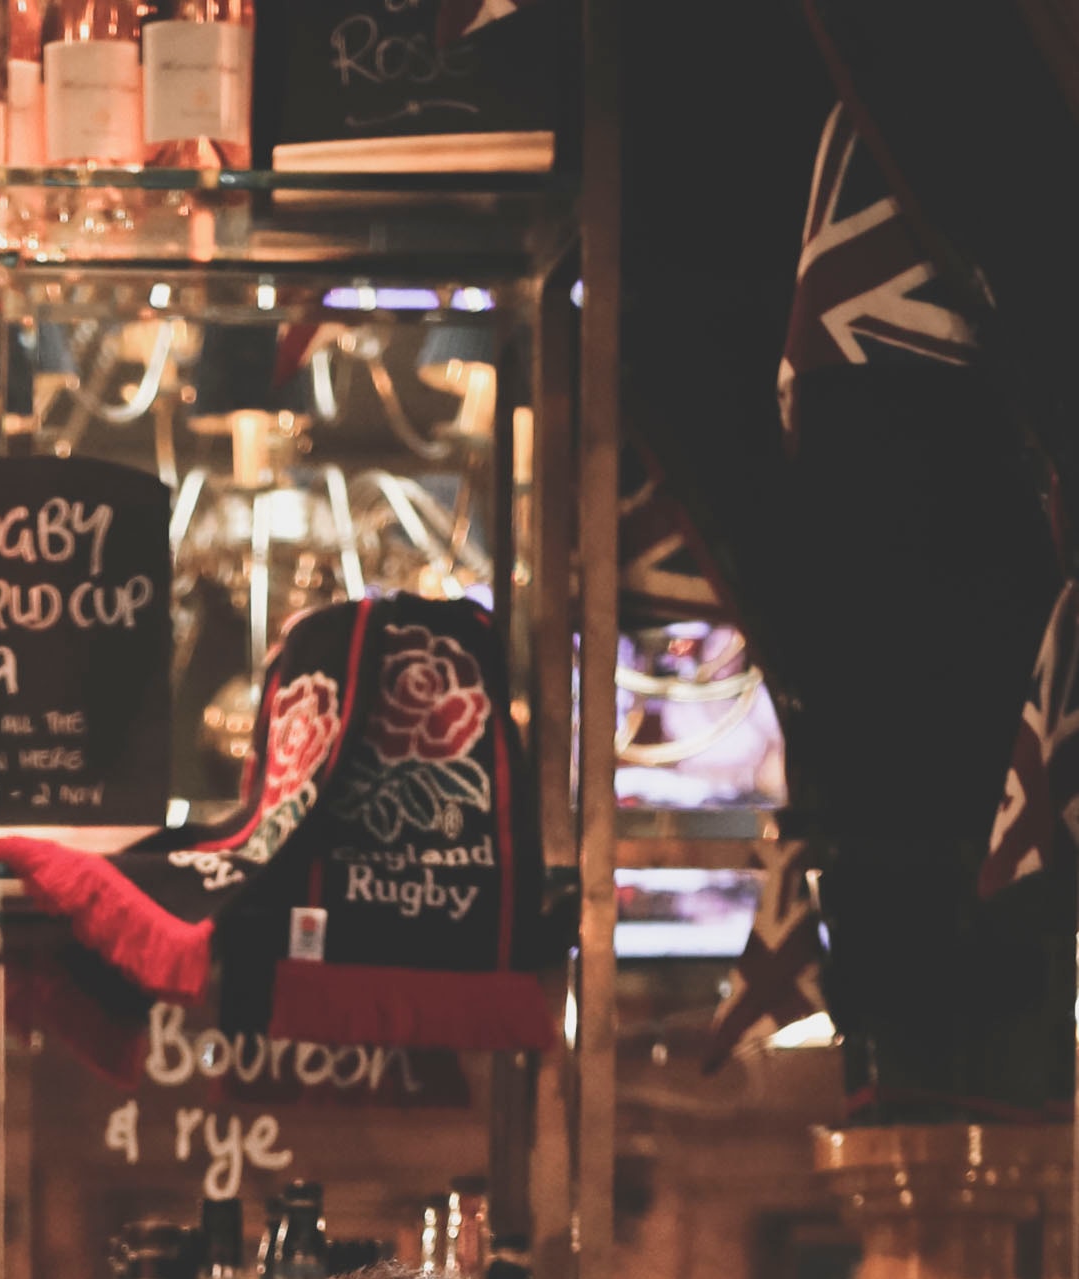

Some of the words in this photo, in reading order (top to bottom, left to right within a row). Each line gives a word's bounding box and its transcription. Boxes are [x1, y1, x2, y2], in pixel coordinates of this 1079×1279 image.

[68, 575, 153, 629] CUP
[344, 862, 480, 922] Rugby
[173, 1106, 294, 1200] rye
